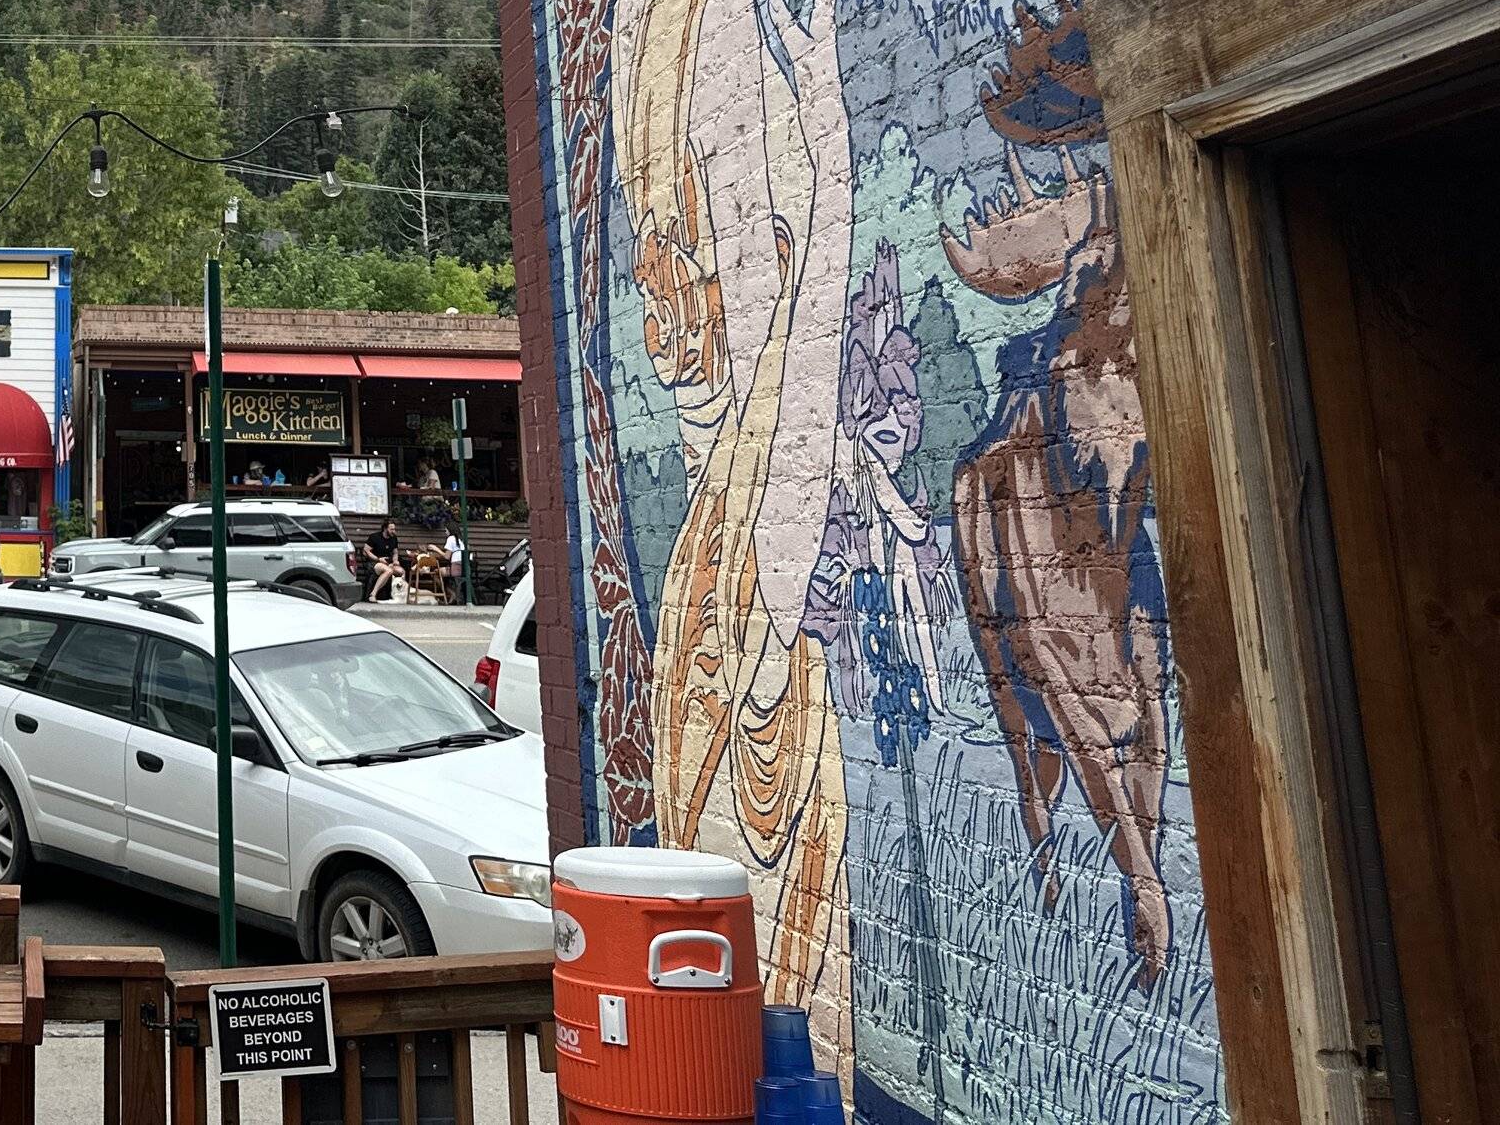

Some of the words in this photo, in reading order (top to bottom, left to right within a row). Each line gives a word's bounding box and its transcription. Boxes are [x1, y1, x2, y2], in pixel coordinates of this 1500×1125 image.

[204, 391, 301, 429] Maggie's
[272, 410, 341, 431] Kitchen
[236, 431, 267, 440] Lunch
[269, 432, 277, 440] &
[280, 432, 312, 441] Dinner
[218, 997, 239, 1011] NO
[241, 992, 322, 1009] ALCOHOLIC
[229, 1010, 314, 1028] BEVERAGES
[244, 1030, 302, 1046] BEYOND
[236, 1051, 268, 1065] THIS
[271, 1048, 313, 1063] POINT
